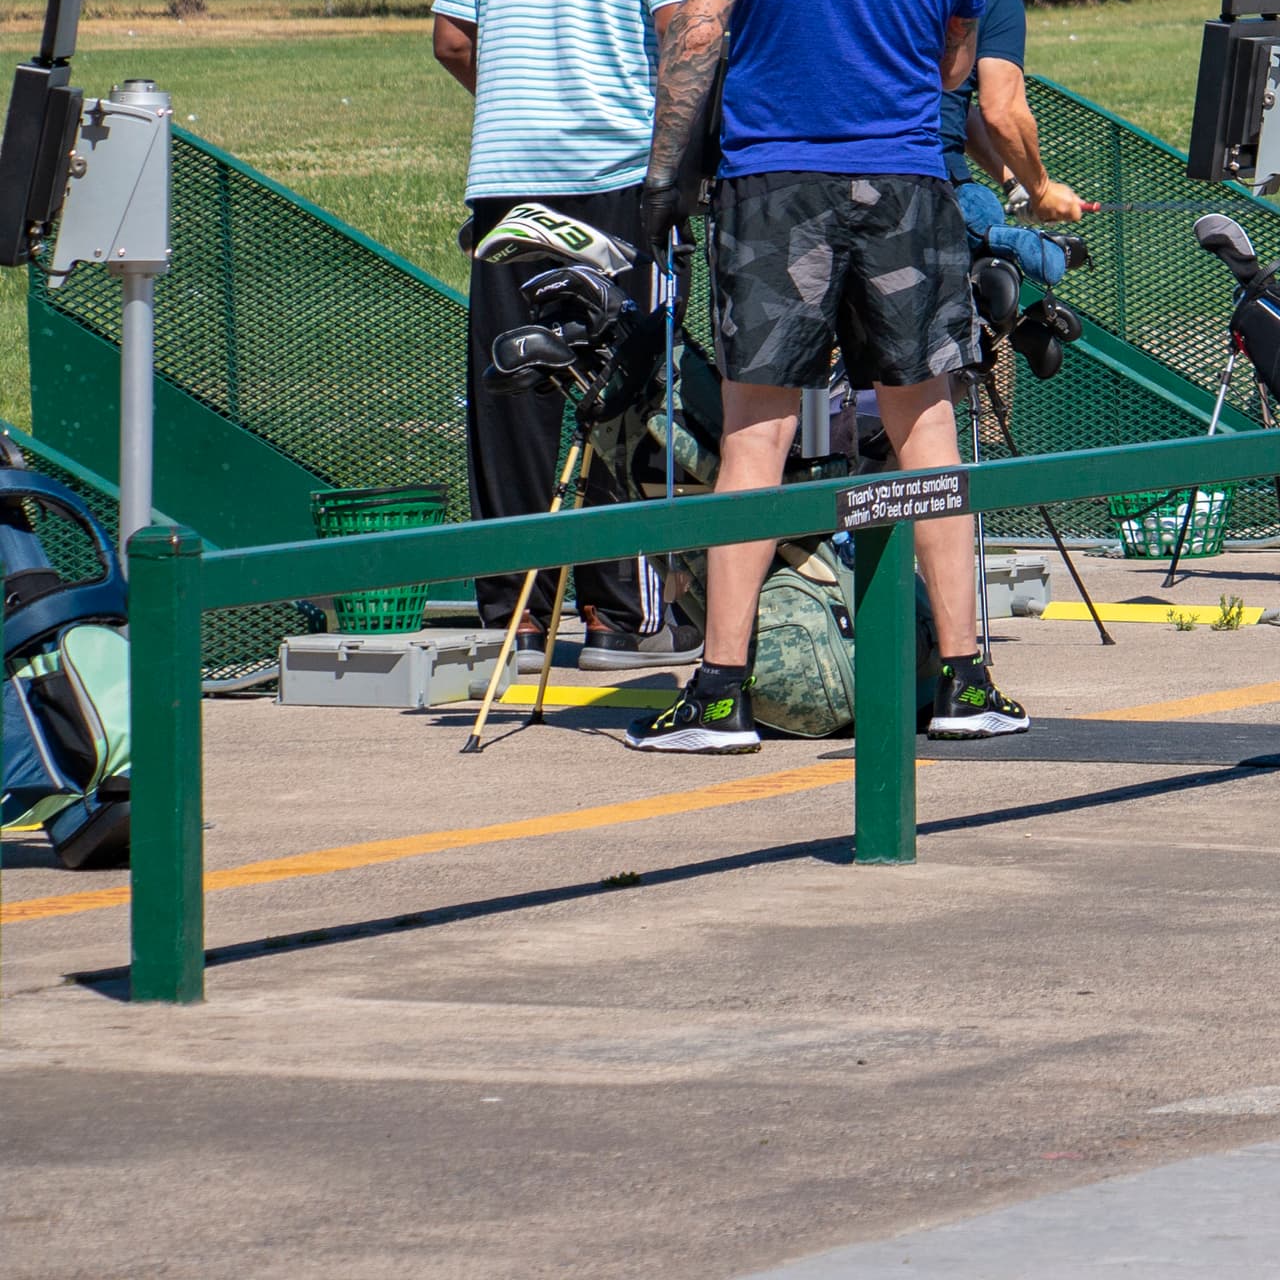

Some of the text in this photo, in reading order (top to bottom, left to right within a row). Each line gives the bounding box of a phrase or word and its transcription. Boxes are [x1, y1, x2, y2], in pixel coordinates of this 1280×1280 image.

[536, 279, 569, 296] APEX
[515, 337, 526, 356] 7
[847, 474, 959, 507] Thank you for not smoking
[844, 508, 871, 528] within
[872, 502, 886, 519] 30
[903, 499, 913, 516] of
[914, 500, 929, 514] our
[930, 497, 945, 512] tee
[946, 493, 962, 509] line
